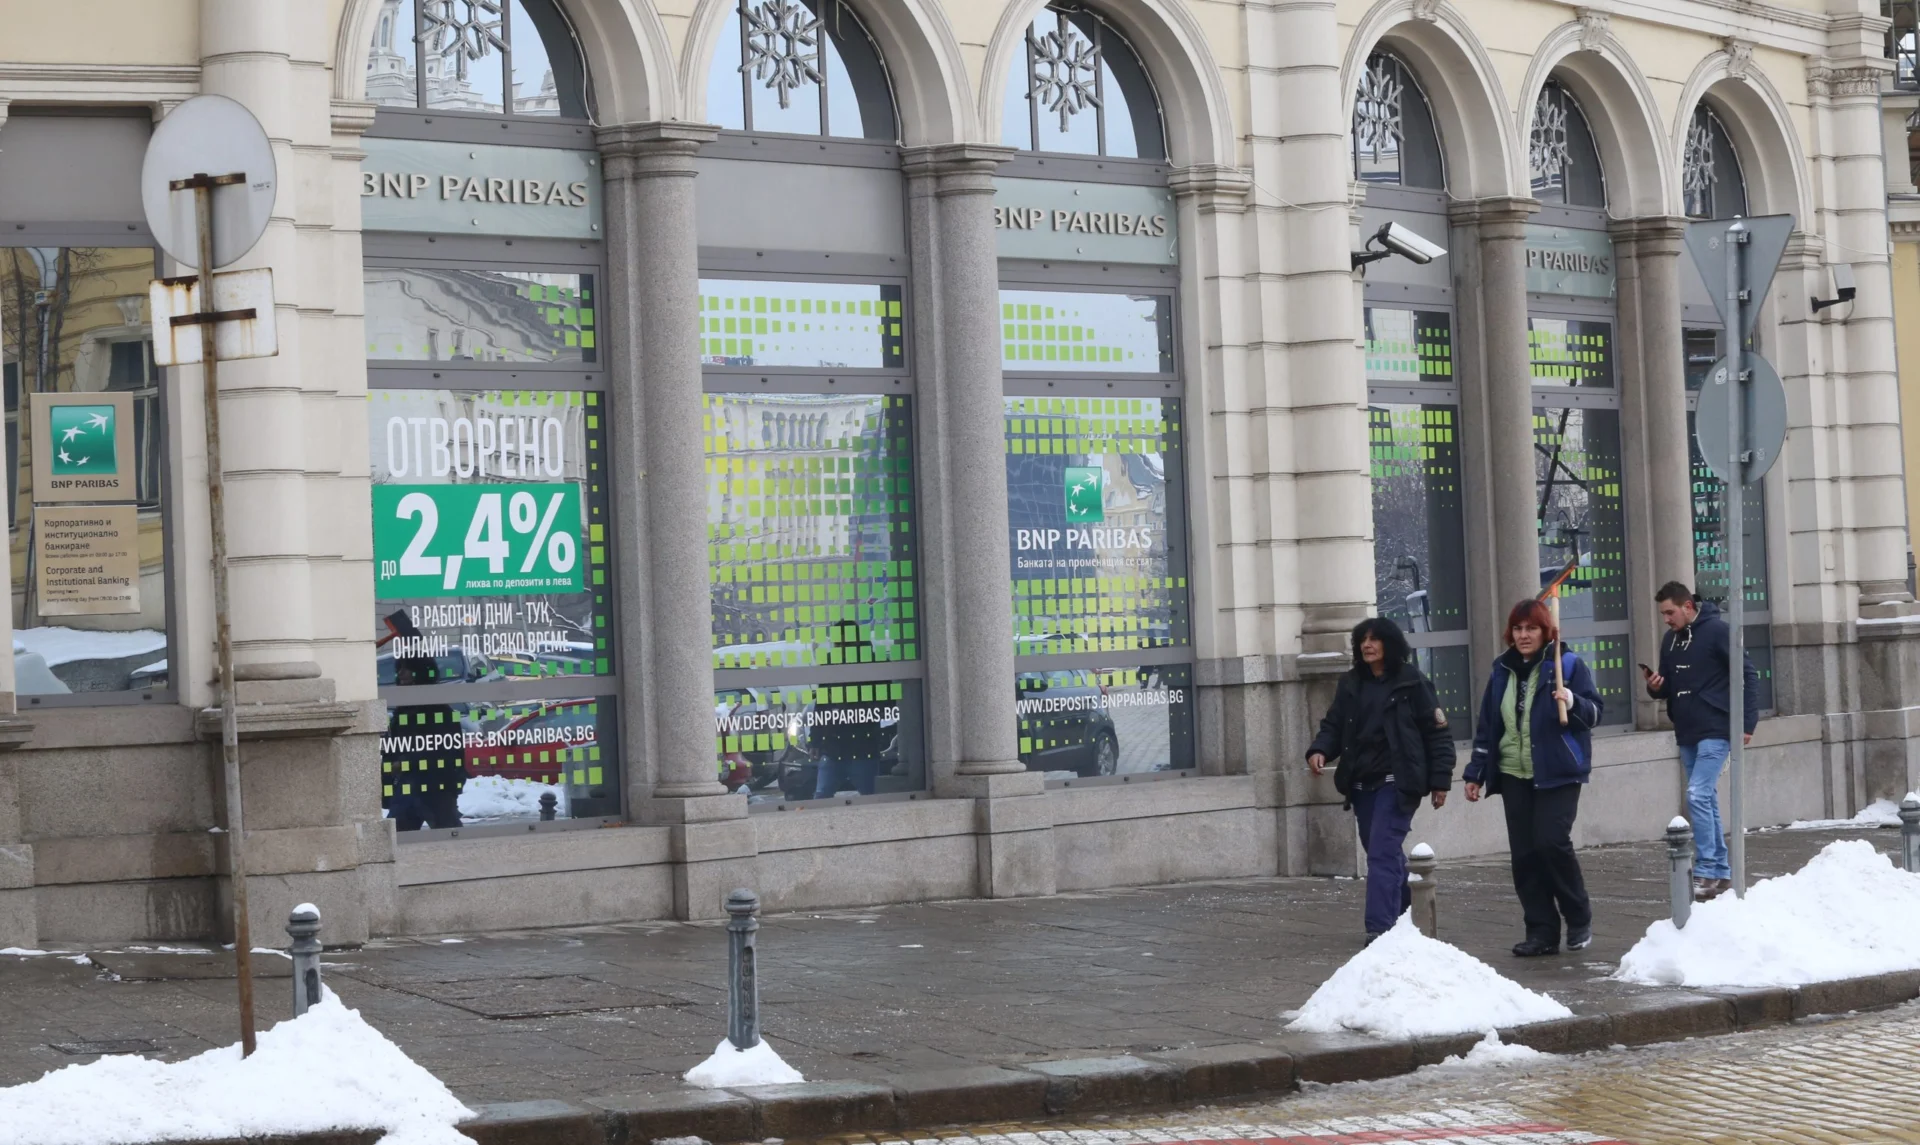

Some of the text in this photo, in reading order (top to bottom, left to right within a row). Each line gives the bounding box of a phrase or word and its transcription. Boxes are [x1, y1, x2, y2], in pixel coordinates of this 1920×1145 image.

[360, 171, 588, 207] BNP PARIBAS
[1052, 209, 1167, 237] PARIBAS
[1541, 250, 1609, 275] PARIBAS
[386, 416, 564, 478] ОТВОРЕНО
[51, 479, 119, 489] BNP PARIBAS
[44, 519, 104, 529] Корпоративно
[45, 530, 118, 540] институционално
[45, 542, 90, 551] банкиране
[396, 491, 576, 590] 2,4%
[1017, 528, 1153, 550] BNP PARIBAS
[46, 565, 103, 575] Corporate and
[1017, 556, 1153, 569] Банката на променящия се свят
[46, 576, 130, 586] Institutional Banking
[465, 577, 572, 589] лихва по депозити в лева
[411, 605, 420, 628] В
[424, 603, 482, 628] РАБОТНИ
[484, 602, 513, 629] ДНИ
[526, 601, 553, 627] ТУК,
[392, 631, 449, 660] ОНЛАЙН
[462, 634, 480, 656] ПО
[483, 632, 525, 655] ВСЯКО
[528, 630, 573, 654] ВРЕМЕ.
[379, 724, 595, 754] WW.DEPOSITS.BNPPARIBAS.BG
